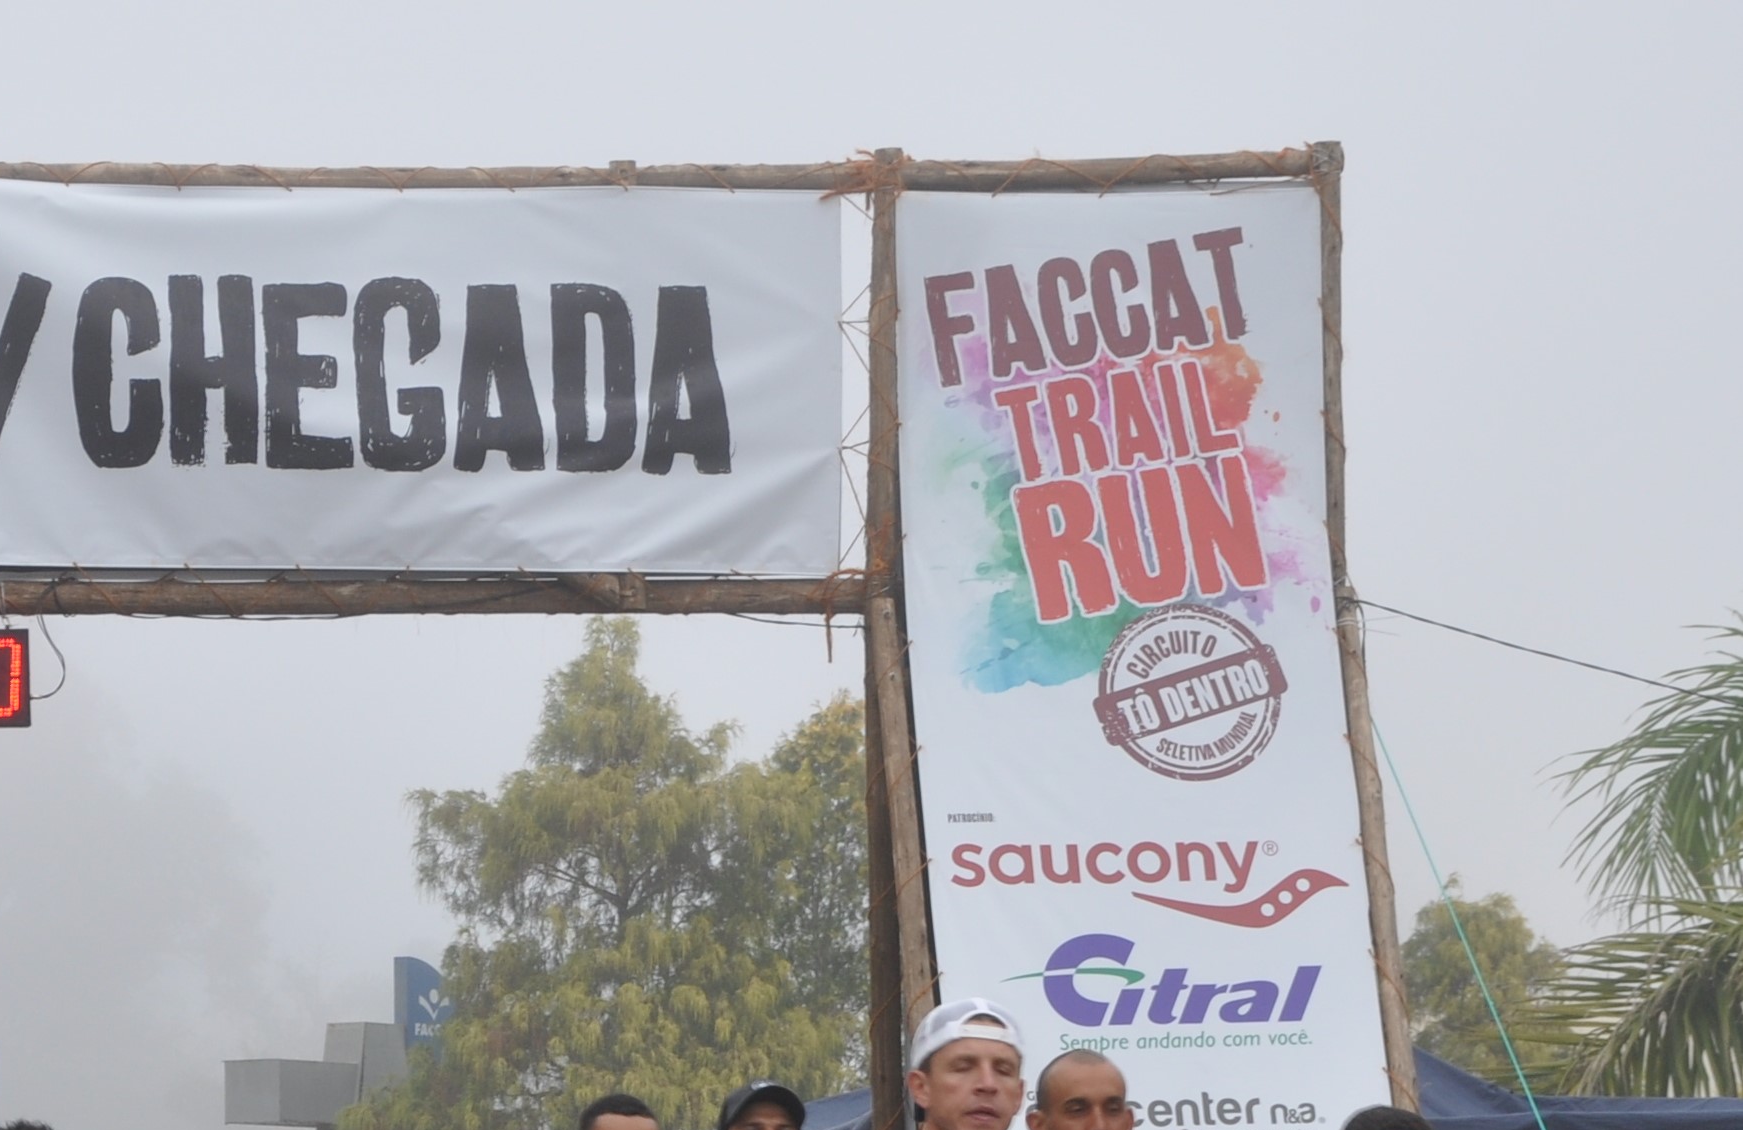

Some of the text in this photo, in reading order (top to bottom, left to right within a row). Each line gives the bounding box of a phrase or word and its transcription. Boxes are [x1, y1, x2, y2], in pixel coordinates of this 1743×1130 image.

[924, 226, 1249, 388] FACCAT
[994, 362, 1241, 481] TRAIL
[1015, 457, 1267, 623] RUN
[1127, 630, 1218, 679] CIRCUITO
[1117, 660, 1270, 734] TÔ DENTRO
[1156, 711, 1258, 763] SELETIVA MUNDIAL
[1043, 933, 1322, 1028] Citral
[1059, 1029, 1313, 1054] Sempre andando com você.
